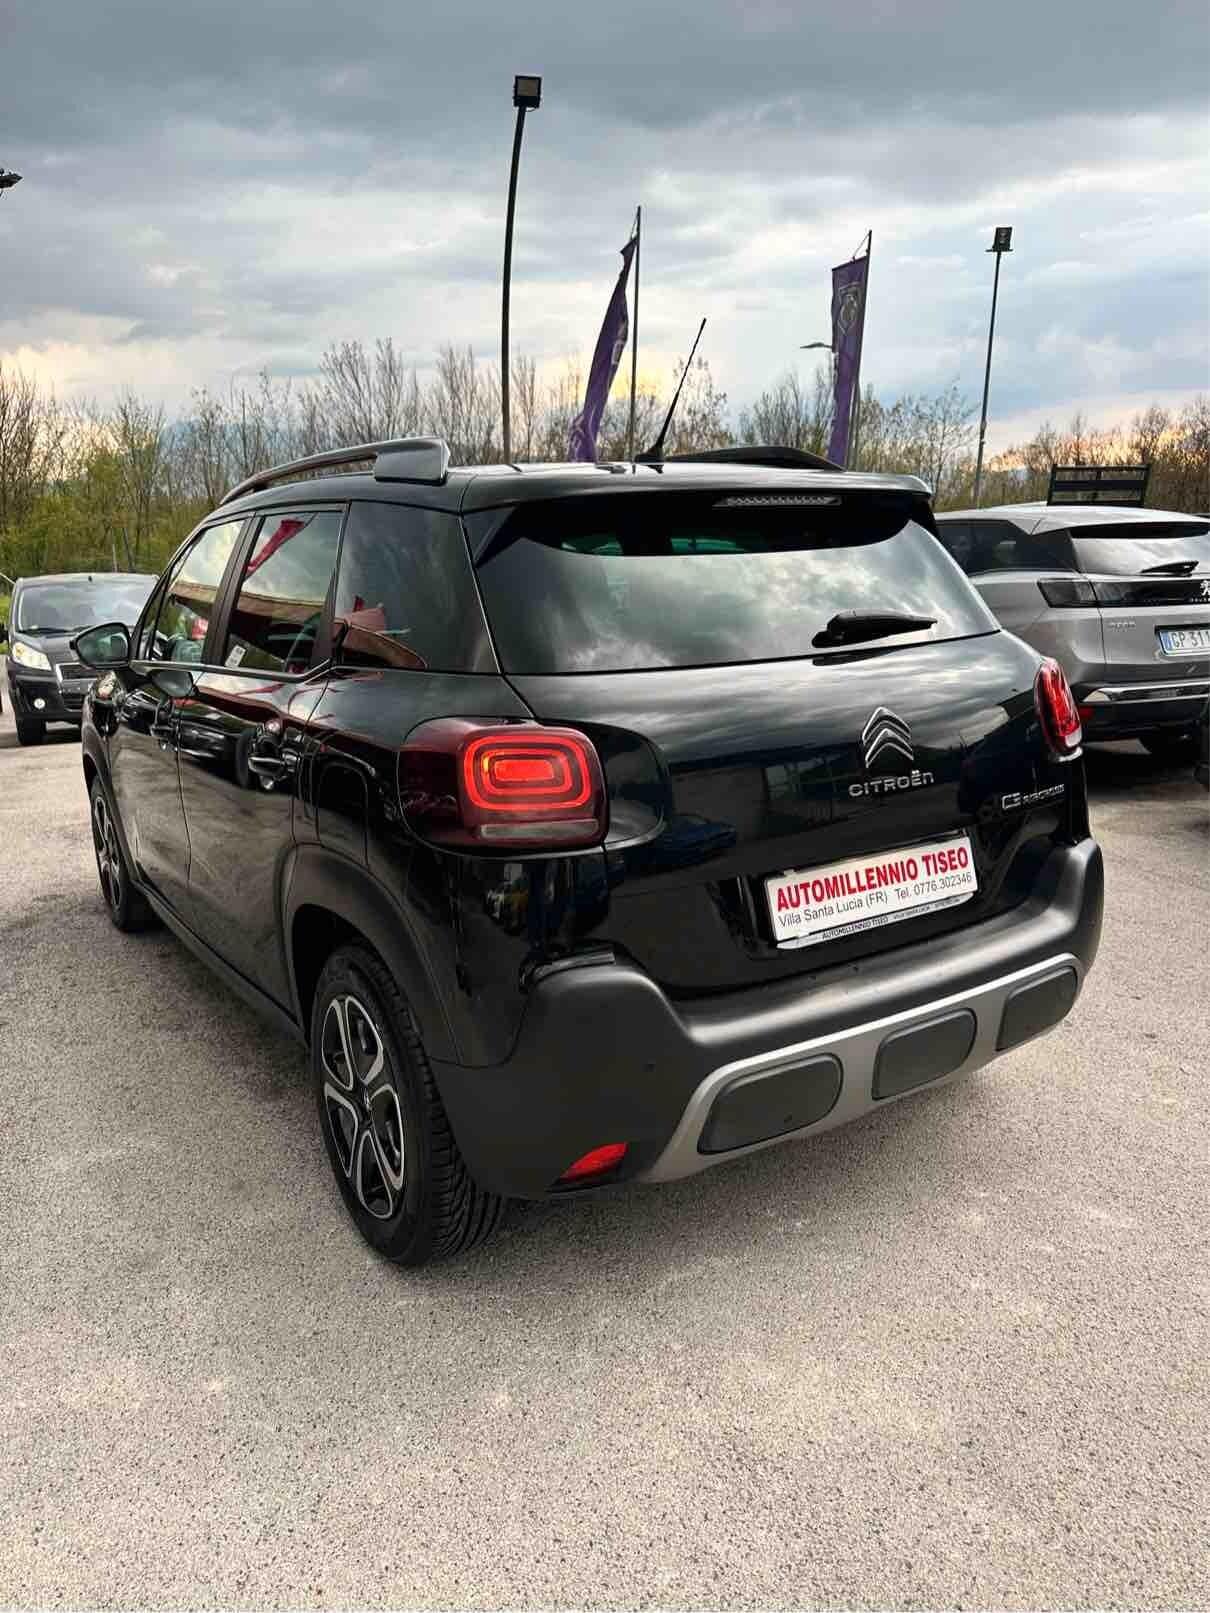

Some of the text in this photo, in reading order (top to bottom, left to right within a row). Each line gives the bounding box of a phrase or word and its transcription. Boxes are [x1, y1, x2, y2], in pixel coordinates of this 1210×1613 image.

[777, 847, 969, 912] AUTOMILLENNIO TISEO
[778, 913, 802, 928] Villa
[803, 906, 834, 922] Santa
[837, 898, 864, 914] Lucia
[865, 891, 888, 910] (FR)
[894, 887, 912, 900] Tel.
